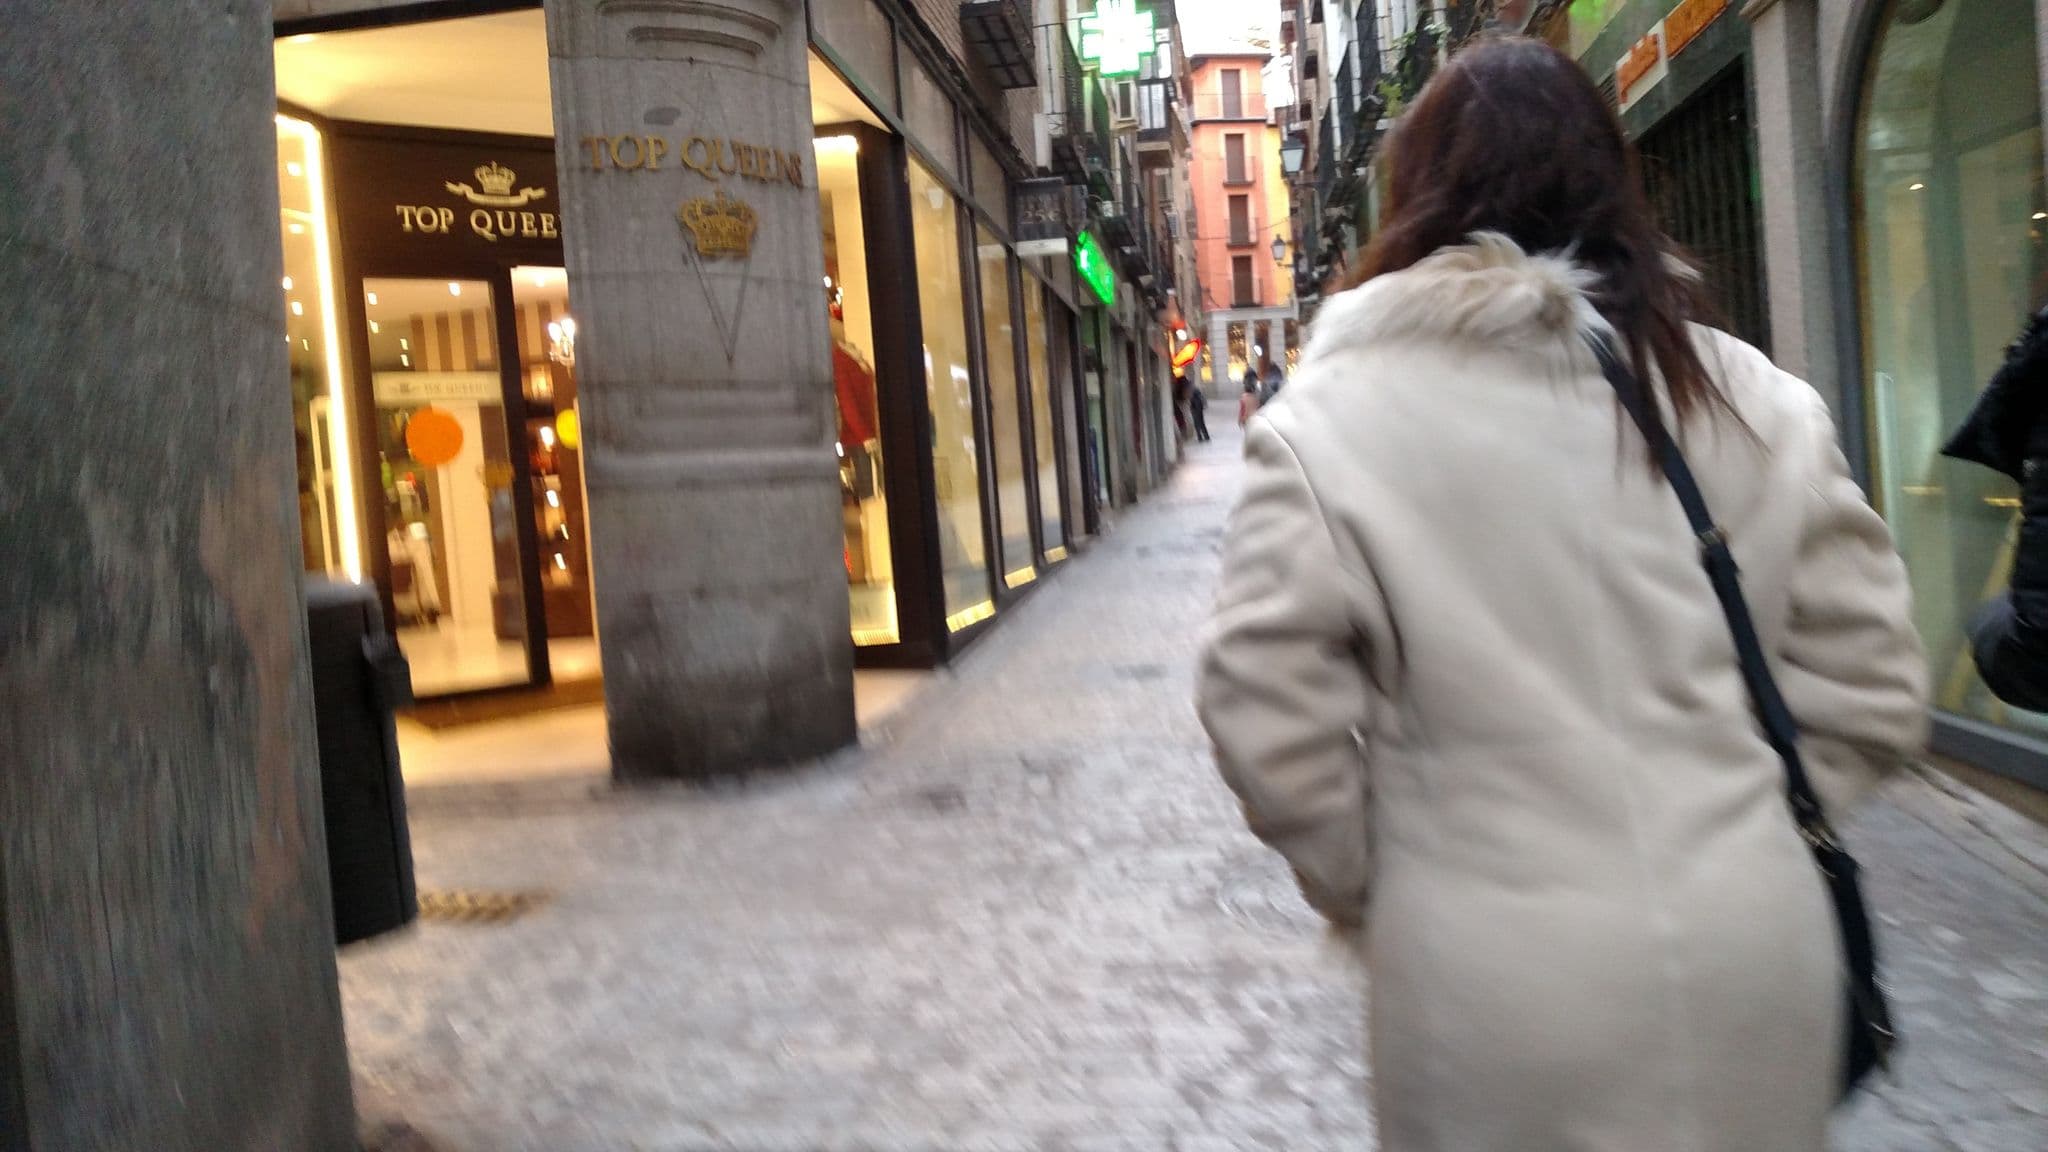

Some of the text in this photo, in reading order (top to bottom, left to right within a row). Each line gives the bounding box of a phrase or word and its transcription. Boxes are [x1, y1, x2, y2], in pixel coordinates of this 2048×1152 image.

[581, 134, 803, 190] TOP QUEENS
[395, 204, 561, 242] TOP QUEE
